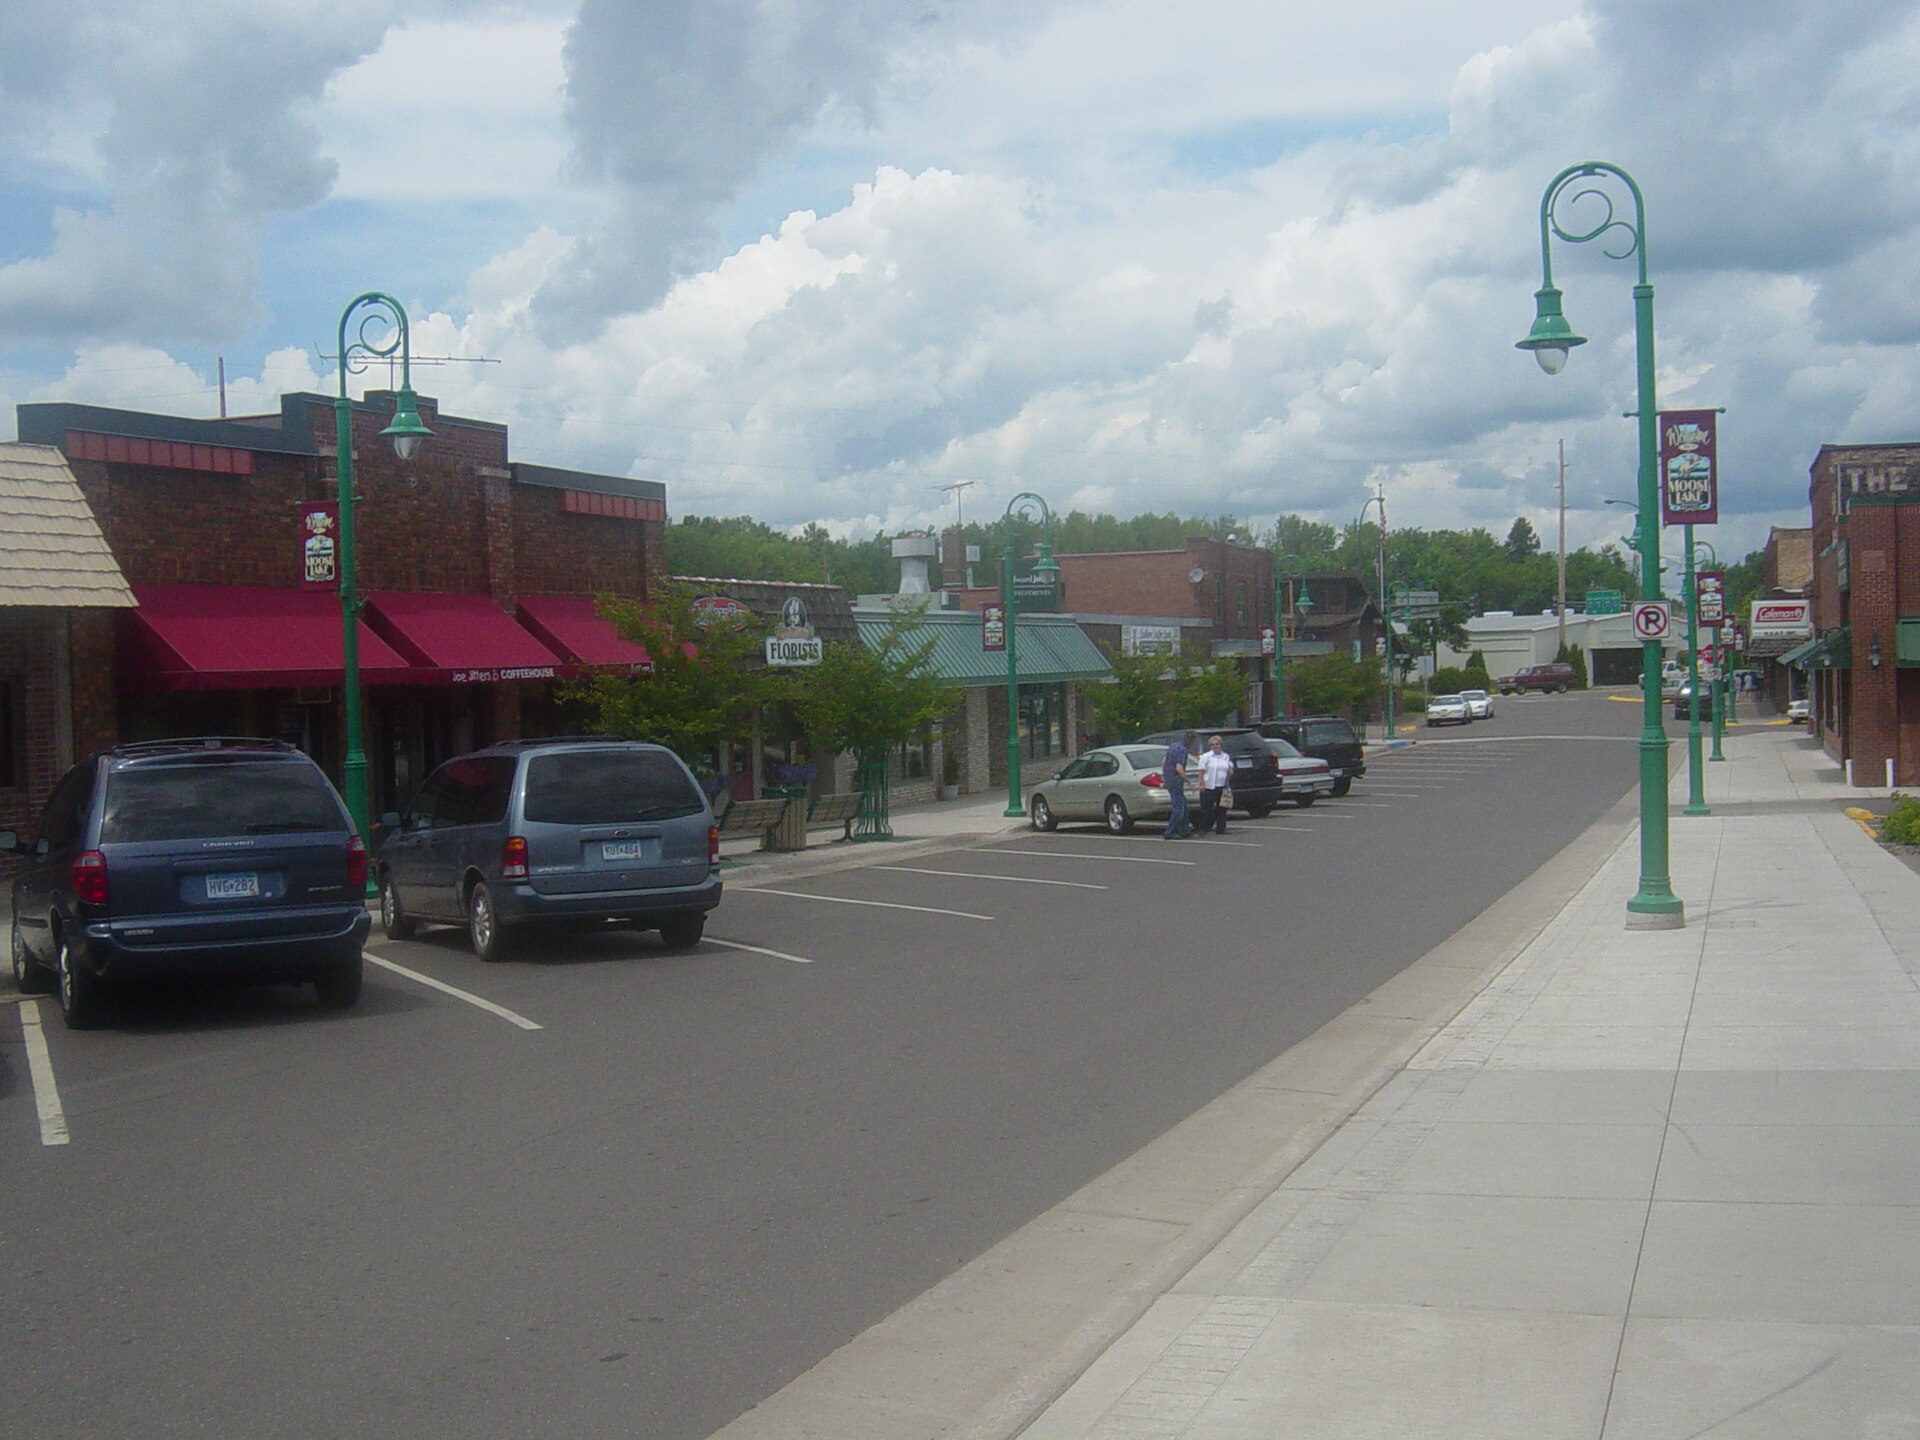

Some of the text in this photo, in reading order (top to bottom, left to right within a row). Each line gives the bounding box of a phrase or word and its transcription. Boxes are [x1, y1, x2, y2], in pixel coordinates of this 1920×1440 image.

[1665, 424, 1710, 448] Welcome
[1668, 479, 1709, 493] MOOSE
[1846, 466, 1908, 493] THE
[1675, 490, 1702, 505] LAKE
[1759, 607, 1795, 619] Coleman
[770, 642, 819, 660] FLORISTS
[500, 667, 555, 680] COFFEEHOUSE
